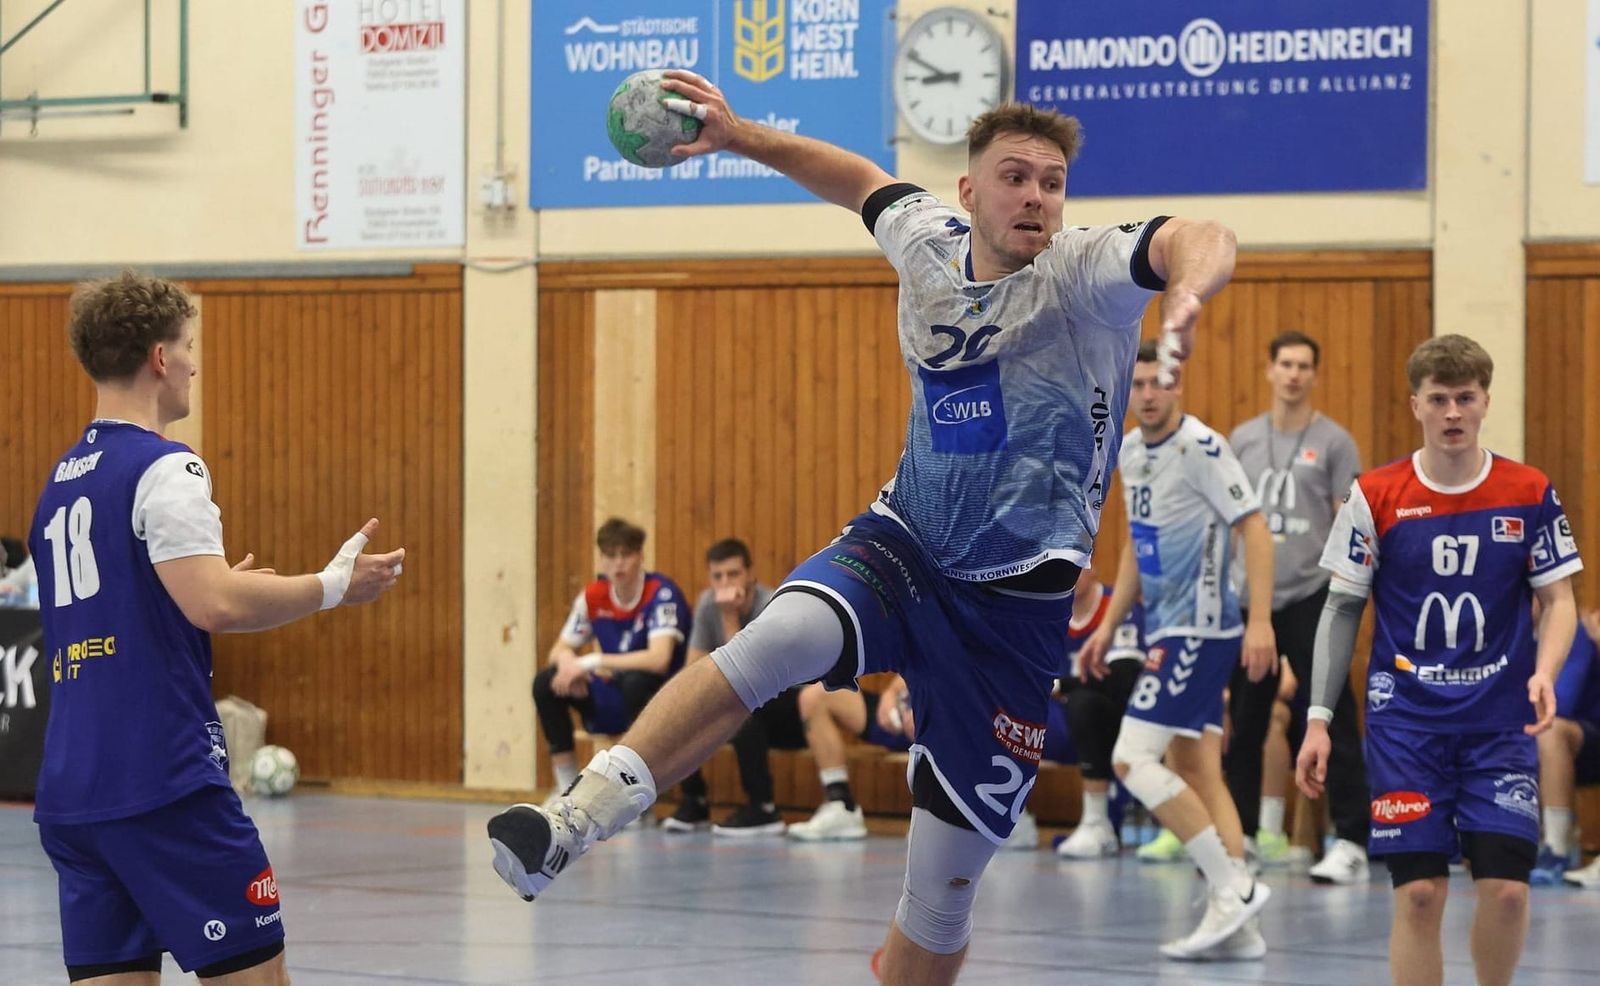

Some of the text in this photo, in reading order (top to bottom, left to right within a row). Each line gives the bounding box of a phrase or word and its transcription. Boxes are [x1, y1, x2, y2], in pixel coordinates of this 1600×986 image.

[620, 17, 698, 36] STÄDTISCHE
[790, 0, 860, 23] KORN
[790, 22, 859, 51] WEST
[1029, 25, 1412, 71] RAIMONDO HEIDENREICH
[564, 38, 699, 72] WOHNBAU
[1029, 72, 1412, 102] GENERALVERTRETUNG DER ALLIANZ
[305, 51, 335, 243] Renninger
[1130, 486, 1150, 518] 18
[1396, 506, 1432, 518] Kempa
[44, 496, 100, 608] 18
[1432, 535, 1479, 576] 67
